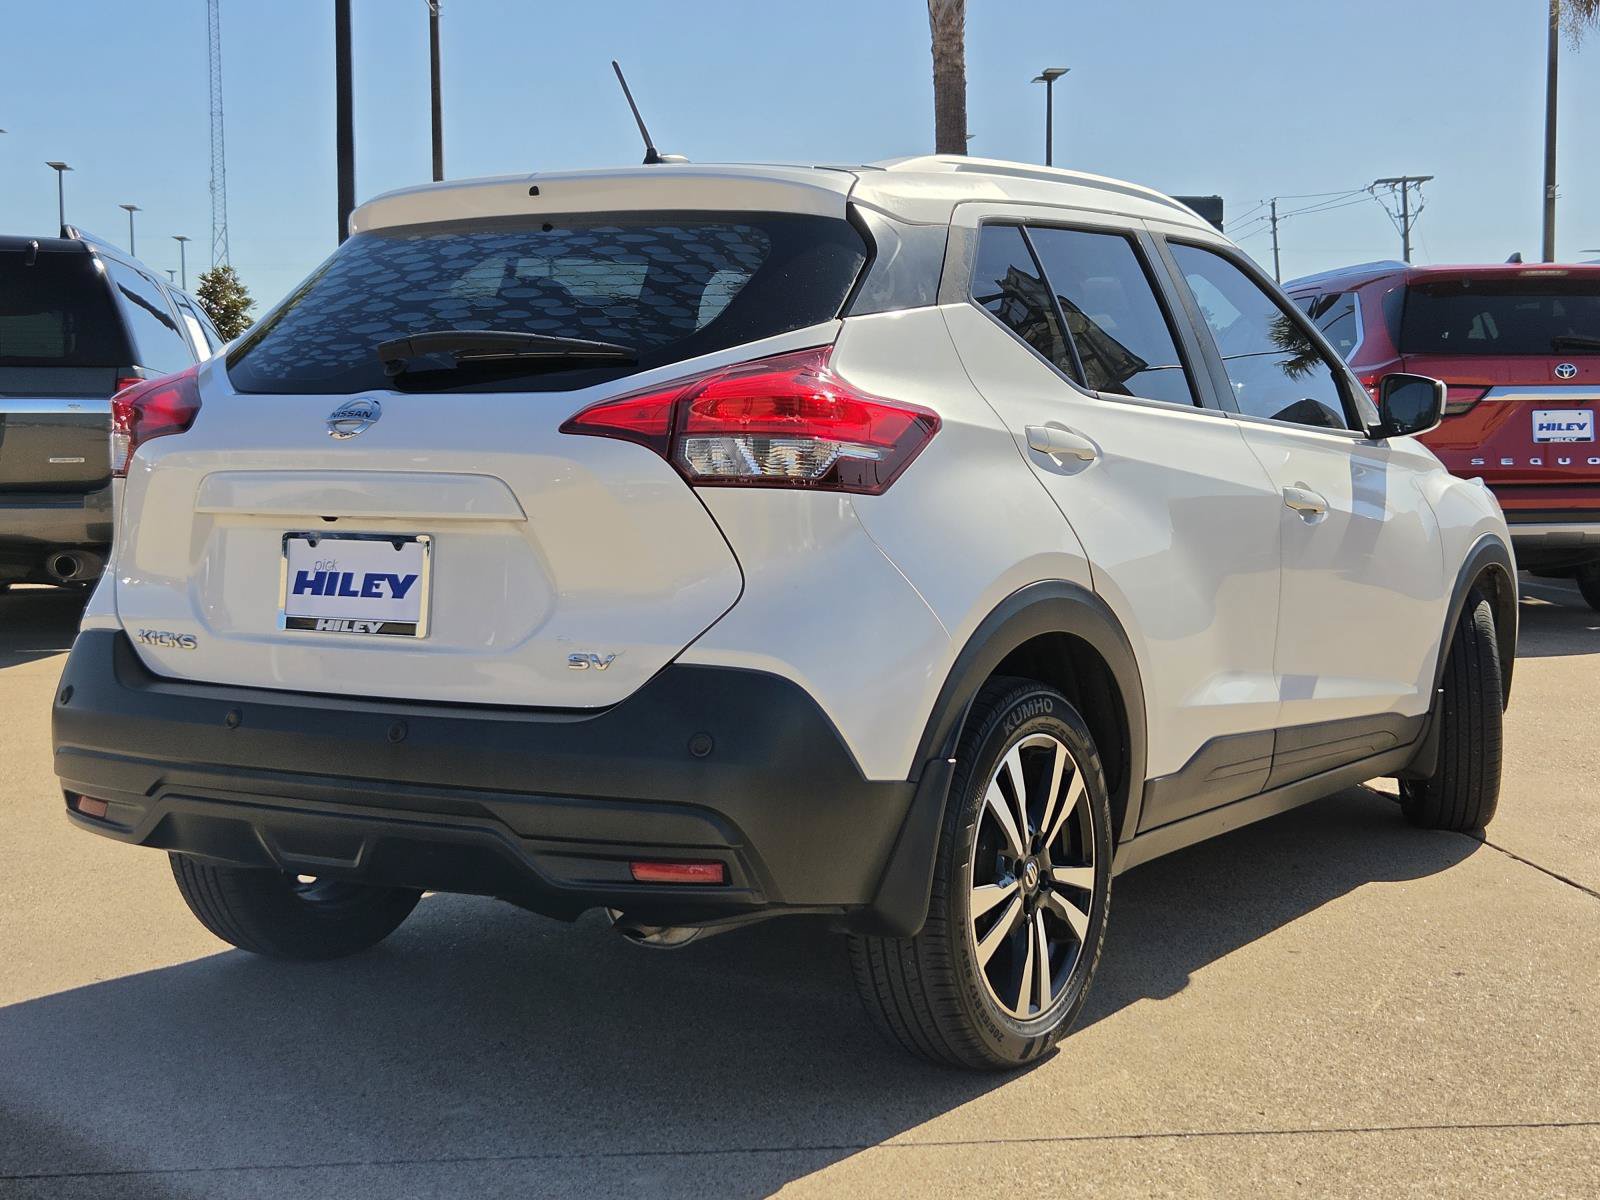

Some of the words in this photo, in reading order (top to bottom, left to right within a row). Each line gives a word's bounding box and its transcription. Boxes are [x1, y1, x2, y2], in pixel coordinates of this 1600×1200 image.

[330, 410, 373, 418] NISSAN
[1538, 423, 1588, 431] HILEY
[313, 560, 338, 572] pick
[292, 570, 419, 599] HILEY
[315, 619, 384, 634] HILEY
[138, 629, 198, 649] KICKS
[568, 654, 616, 670] SV
[1002, 697, 1054, 736] KUMHO
